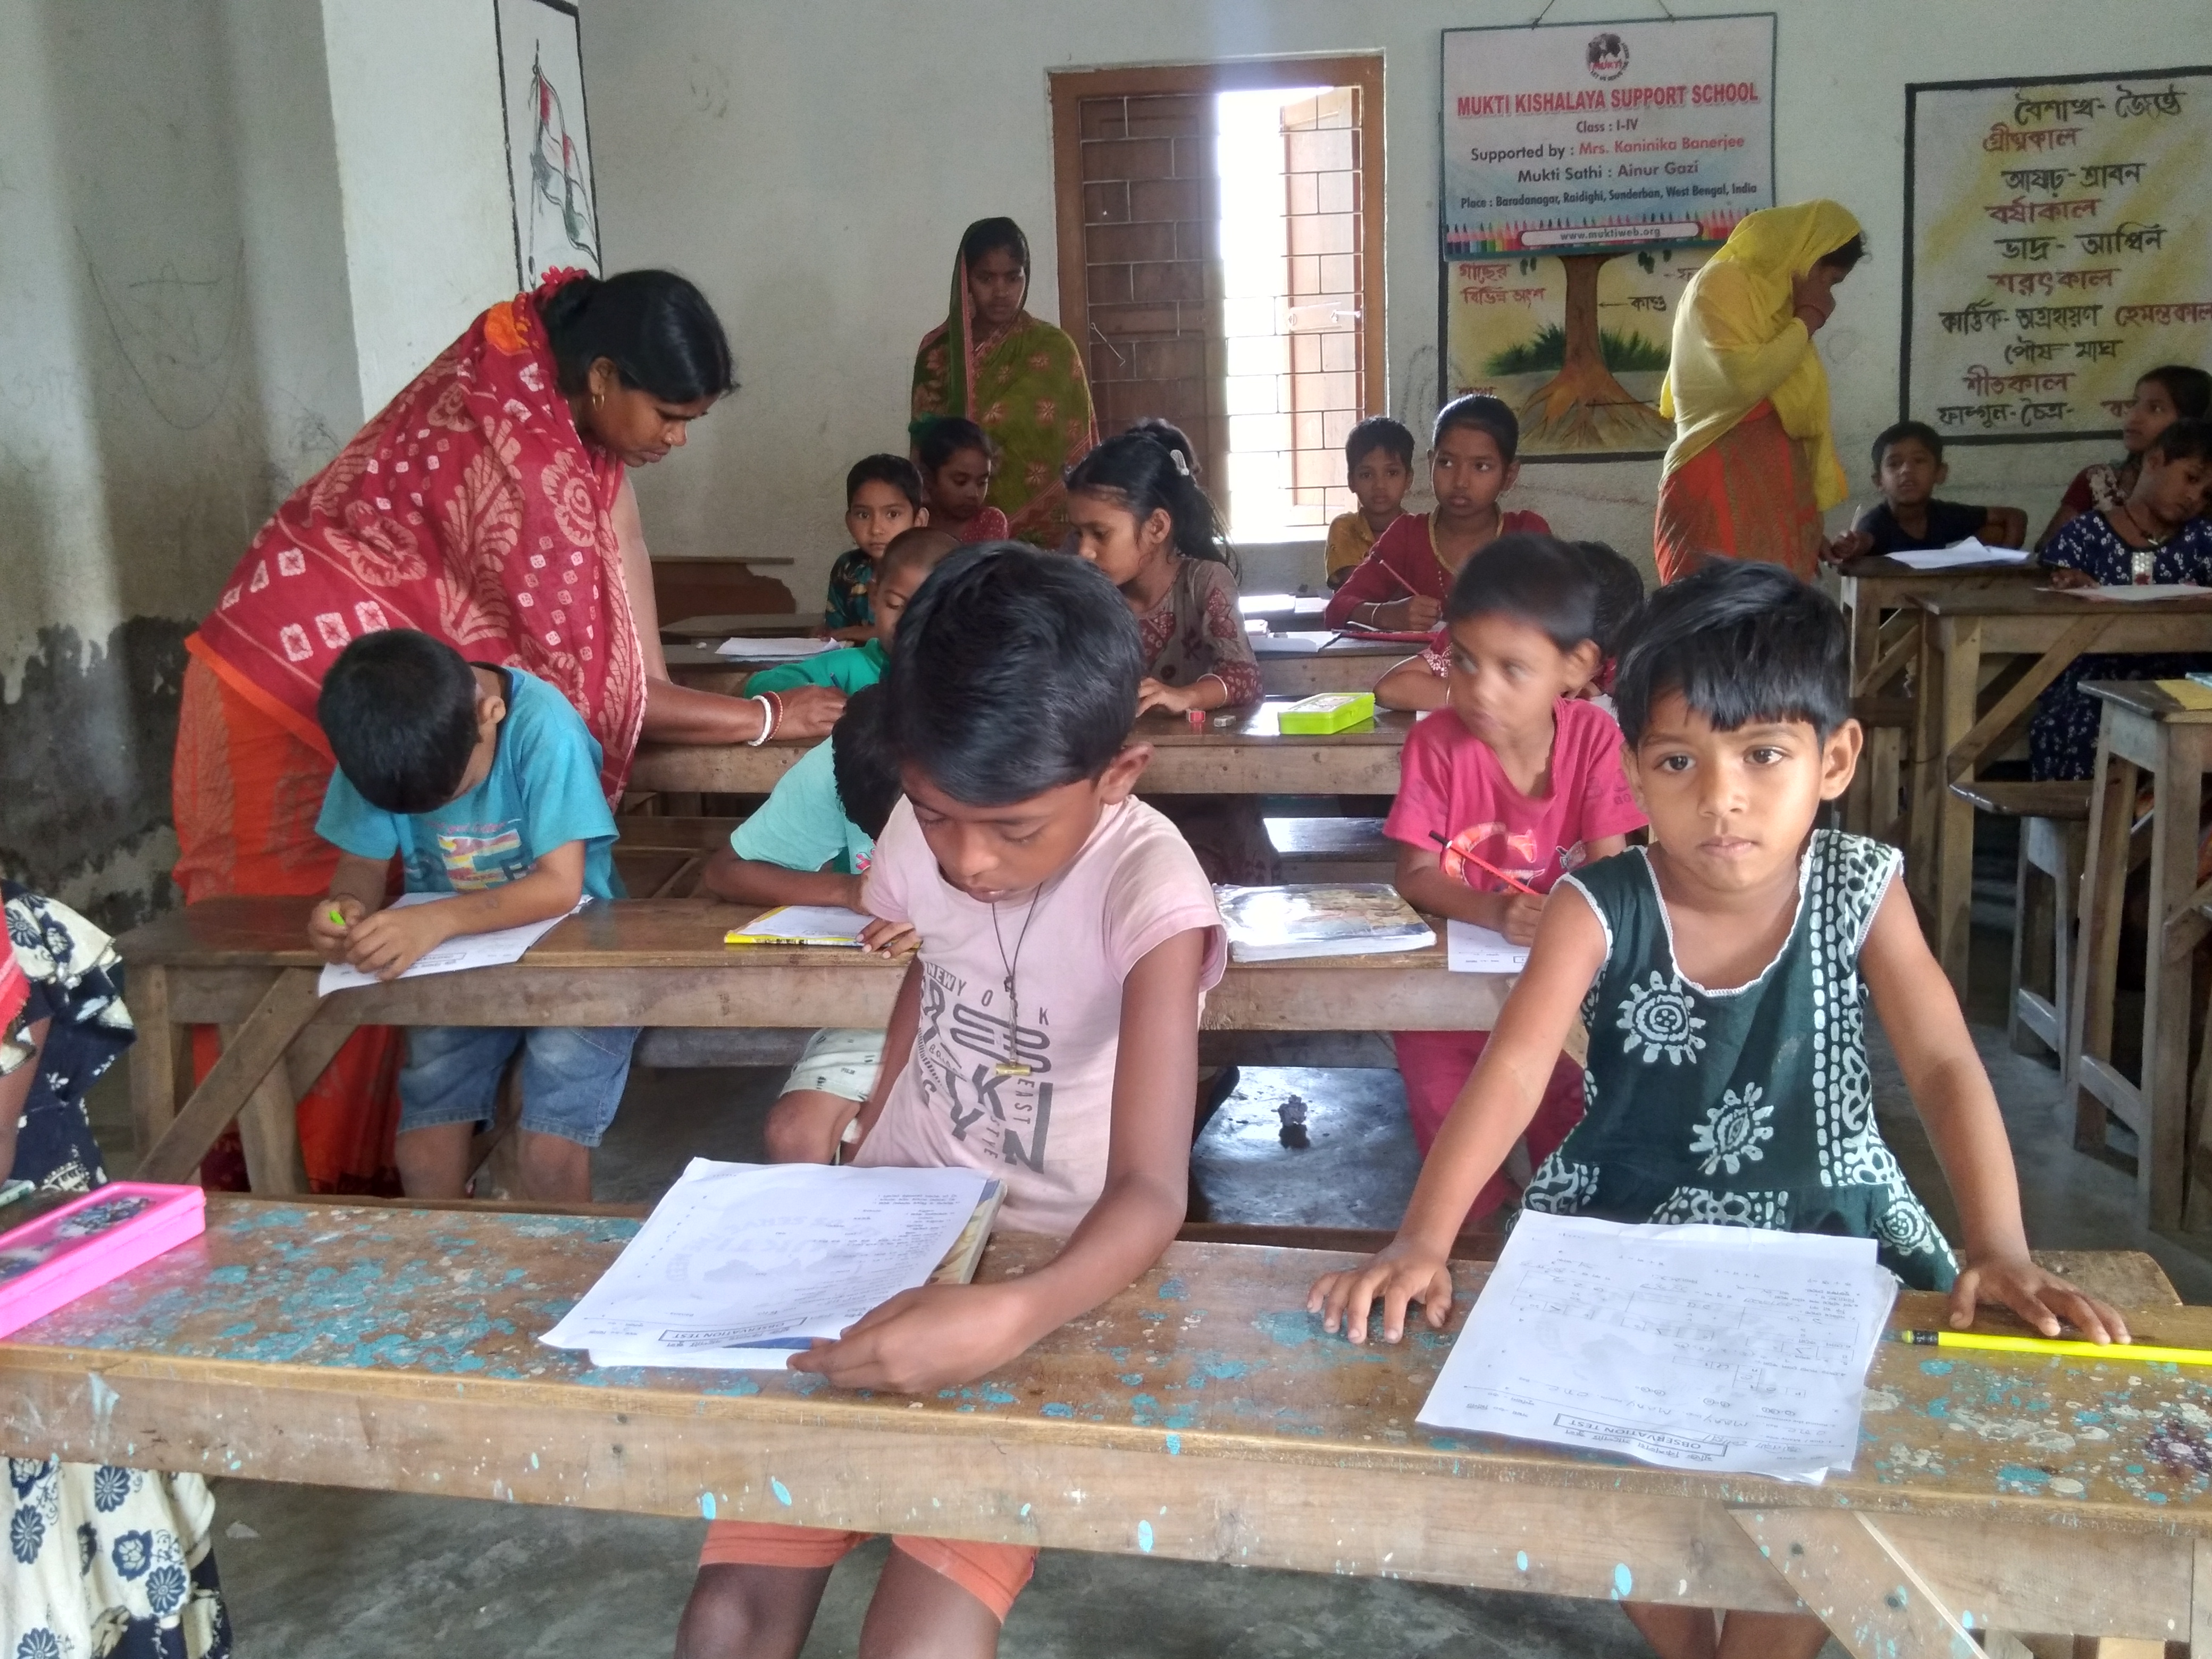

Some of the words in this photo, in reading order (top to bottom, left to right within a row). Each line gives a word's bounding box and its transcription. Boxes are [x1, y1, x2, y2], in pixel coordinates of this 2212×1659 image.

[1457, 94, 1510, 116] MUKTI
[1515, 89, 1605, 113] KISHALAYA
[1611, 86, 1687, 107] SUPPORT
[1691, 82, 1759, 104] SCHOOL
[1576, 121, 1605, 133] Class
[1616, 118, 1638, 131] I-IV
[1471, 144, 1544, 163] Supported
[1548, 144, 1565, 160] by
[1579, 142, 1609, 155] Mrs.
[1614, 138, 1677, 153] Kaninika
[1682, 135, 1745, 150] Banerjee
[1518, 167, 1560, 183] Mukti
[1565, 165, 1602, 180] Sathi
[1618, 164, 1660, 177] Ainur
[1664, 160, 1699, 174] Gazi
[1461, 197, 1486, 209] Place
[1608, 187, 1663, 200] Sunderban,
[1665, 186, 1689, 197] West
[1692, 183, 1729, 197] Bengal,
[1732, 182, 1757, 194] India
[1560, 227, 1660, 240] www.muktiweb.org
[925, 961, 956, 993] NEW
[1013, 1078, 1035, 1125] EAST
[1568, 1420, 1598, 1431] TEST
[1604, 1427, 1701, 1449] OBSERVATION
